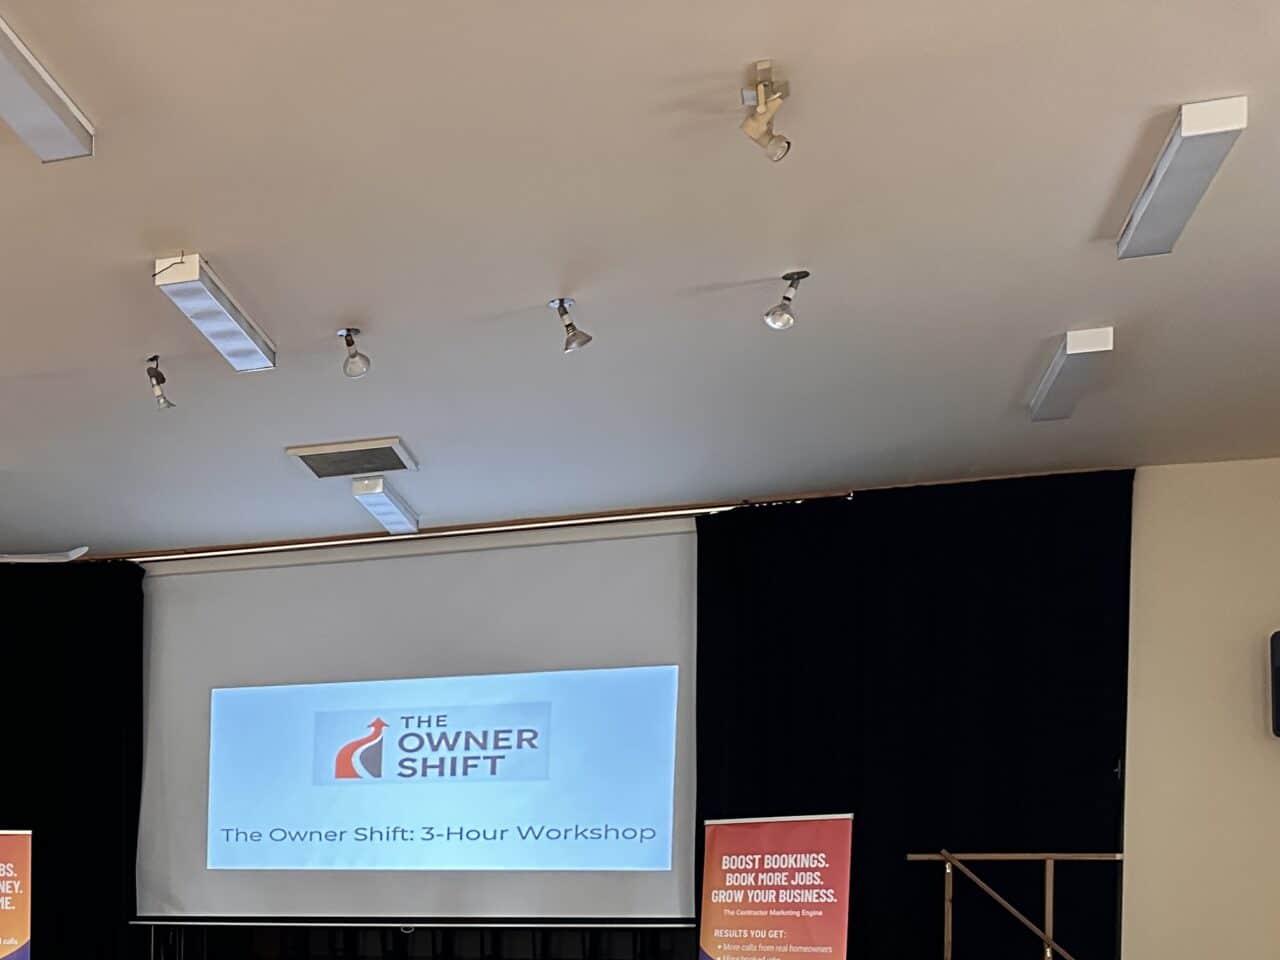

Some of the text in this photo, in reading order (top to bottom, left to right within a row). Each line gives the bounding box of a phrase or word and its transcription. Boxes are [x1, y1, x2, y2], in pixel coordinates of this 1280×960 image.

[400, 714, 447, 729] THE
[398, 729, 539, 753] OWNER
[397, 755, 505, 779] SHIFT
[221, 823, 657, 844] The Owner Shift: 3-Hour Workshop
[721, 853, 829, 870] BOOST BOOKINGS.
[726, 872, 823, 886] BOOK MORE JOBS.
[711, 889, 837, 903] GROW YOUR BUSINESS.
[769, 909, 800, 917] Marketing
[801, 909, 823, 917] Engine
[713, 929, 786, 938] RESULTS YOU GET:
[741, 944, 758, 952] calls
[759, 944, 775, 952] from
[776, 944, 788, 952] real
[789, 944, 833, 953] homeowners
